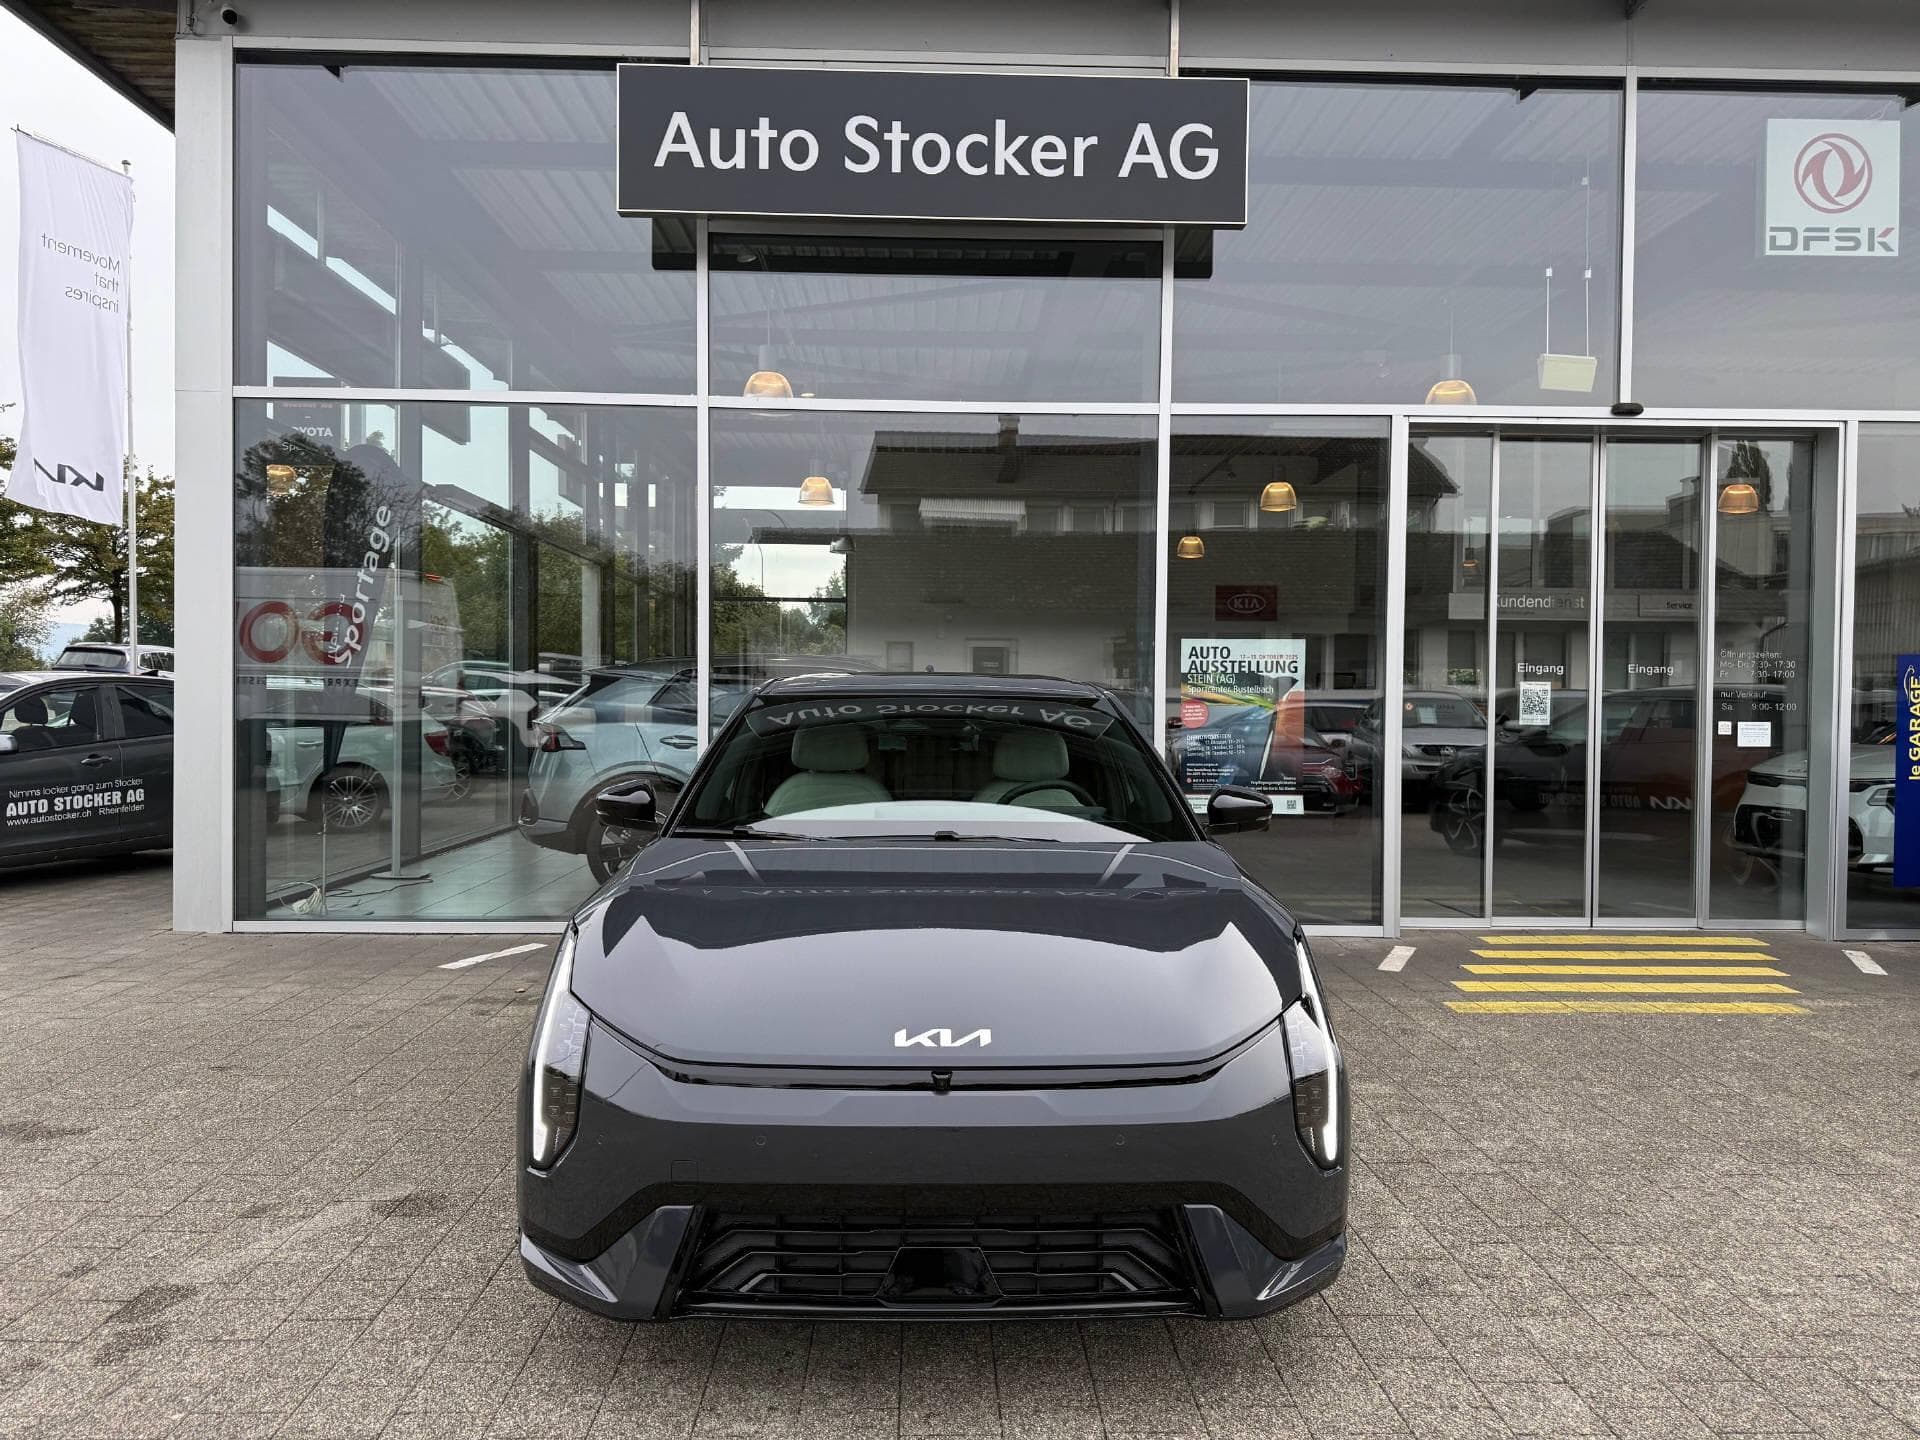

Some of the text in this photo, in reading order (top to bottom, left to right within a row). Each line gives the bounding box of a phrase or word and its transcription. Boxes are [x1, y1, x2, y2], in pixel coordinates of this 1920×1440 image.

[654, 111, 1220, 180] Auto Stocker AG
[1769, 226, 1895, 252] DFSK
[335, 505, 391, 669] Sportage
[1234, 597, 1260, 609] KIA
[1188, 646, 1231, 659] AUTO
[1188, 660, 1298, 673] AUSSTELLUNG
[1517, 662, 1564, 676] Eingang
[1628, 663, 1674, 676] Eingang
[1187, 673, 1236, 684] STEIN (AG)
[96, 781, 113, 790] zum
[114, 777, 144, 788] Stocker
[6, 788, 145, 817] AUTO STOCKER AG
[6, 804, 145, 826] www.autostocker.ch Rheinfelden
[894, 1028, 992, 1047] KIA
